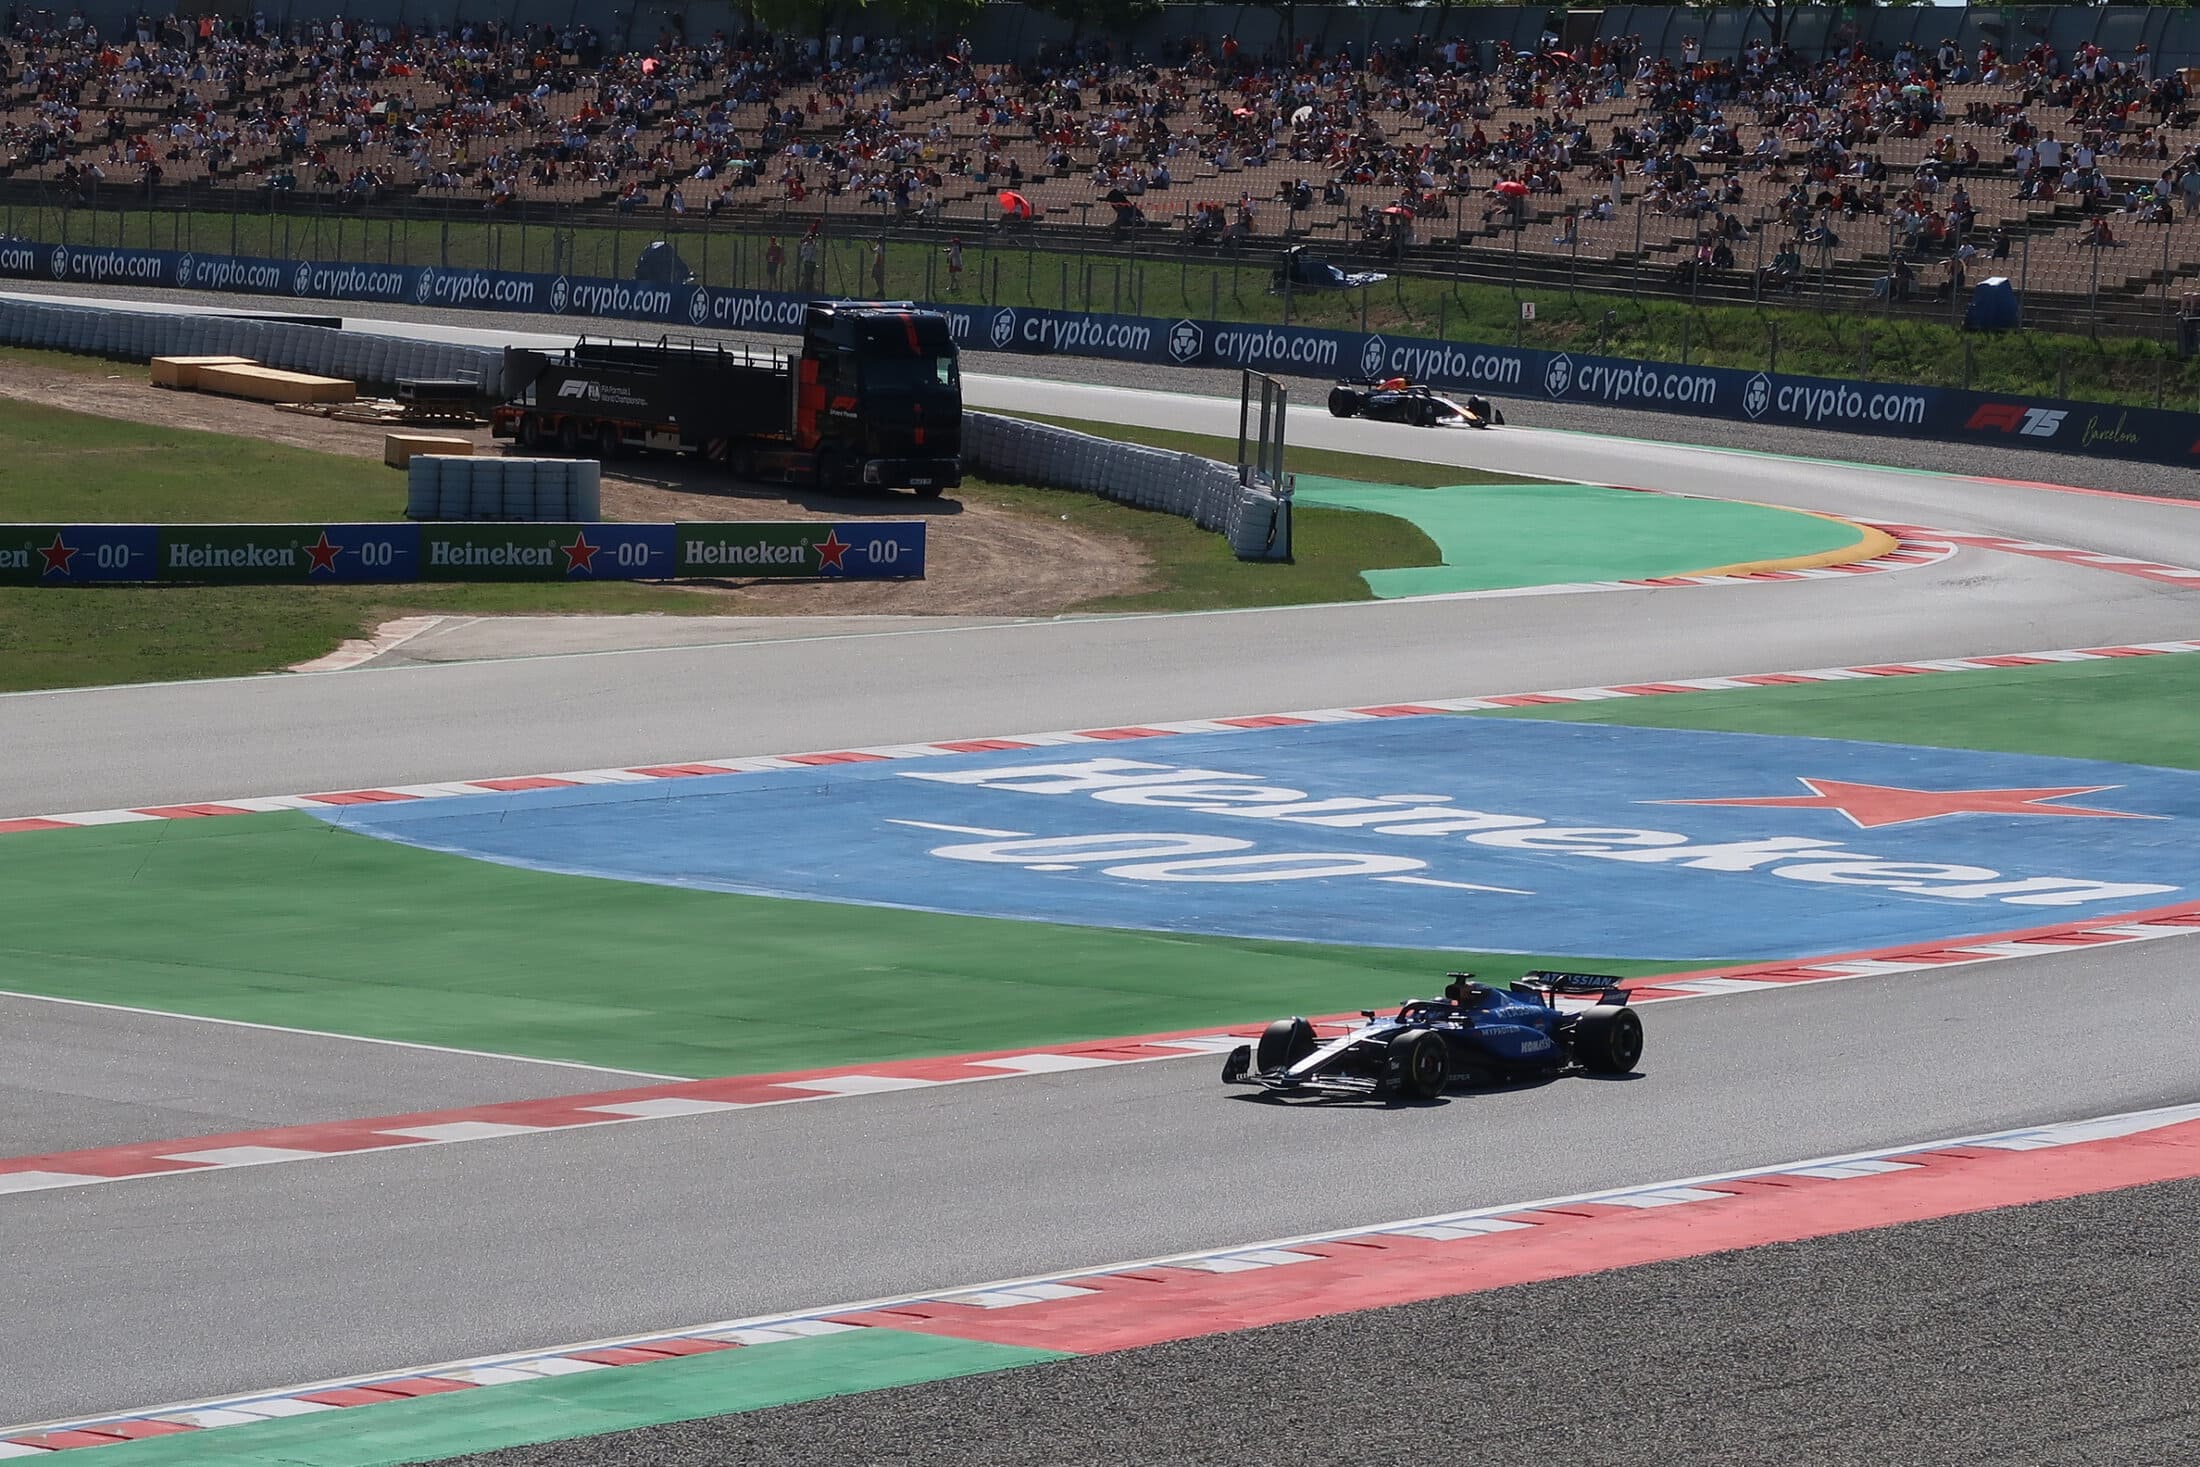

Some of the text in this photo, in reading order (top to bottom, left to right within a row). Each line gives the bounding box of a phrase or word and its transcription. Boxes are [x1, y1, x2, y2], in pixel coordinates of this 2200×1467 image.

[72, 253, 161, 279] crypto.com
[196, 259, 280, 286] crypto.com
[313, 267, 402, 295] crypto.com
[434, 273, 533, 302] crypto.com
[572, 282, 671, 312] crypto.com
[1024, 315, 1150, 349] crypto.com
[1214, 327, 1338, 364] crypto.com
[1391, 347, 1521, 384] crypto.com
[1579, 364, 1716, 401] crypto.com
[1778, 384, 1925, 423] crypto.com
[2019, 408, 2069, 437] 75
[168, 543, 295, 568] Heineken
[430, 541, 553, 567] Heineken
[685, 540, 805, 565] Heineken
[895, 757, 2184, 906] Heineken
